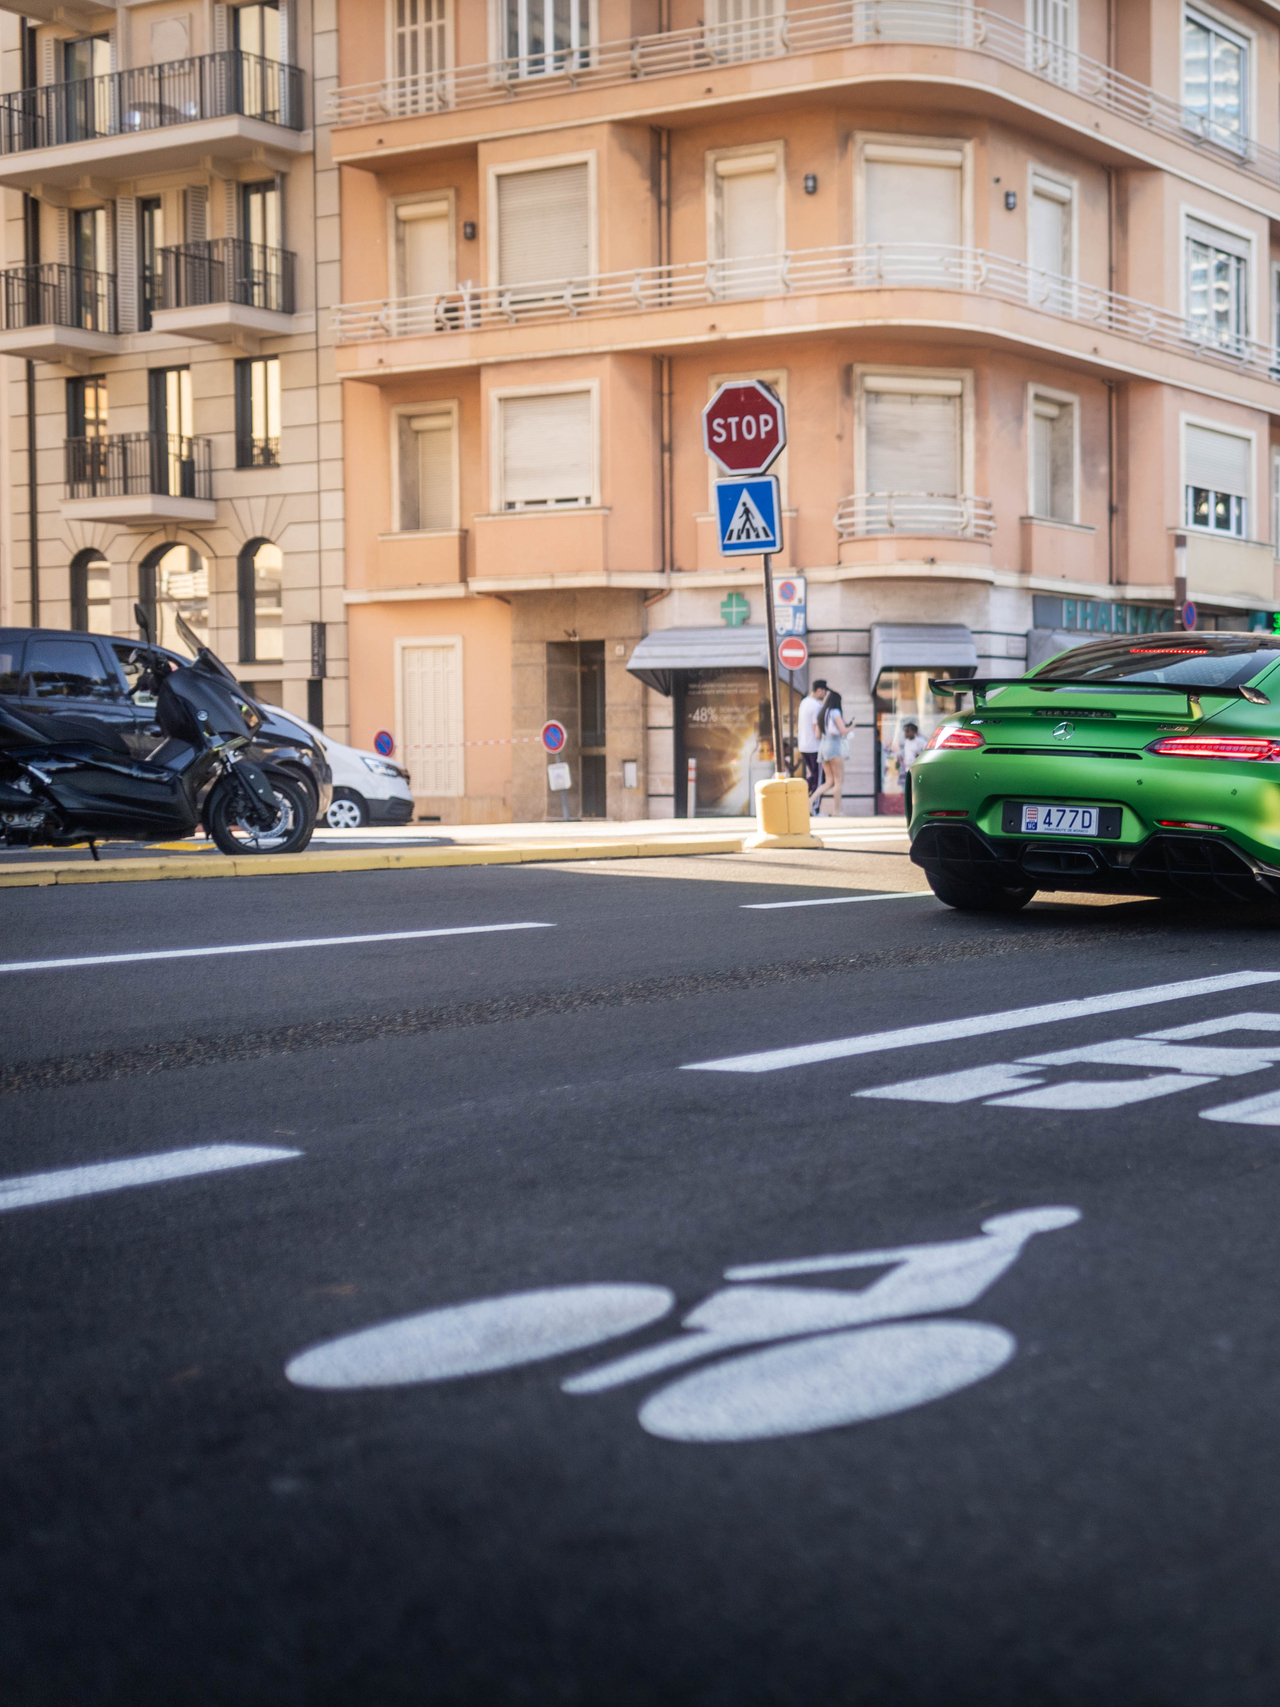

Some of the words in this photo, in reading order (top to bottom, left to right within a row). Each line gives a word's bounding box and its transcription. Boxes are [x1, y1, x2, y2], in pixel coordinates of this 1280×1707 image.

[712, 414, 773, 443] STOP
[1027, 821, 1037, 830] MC
[1043, 809, 1092, 829] 477D
